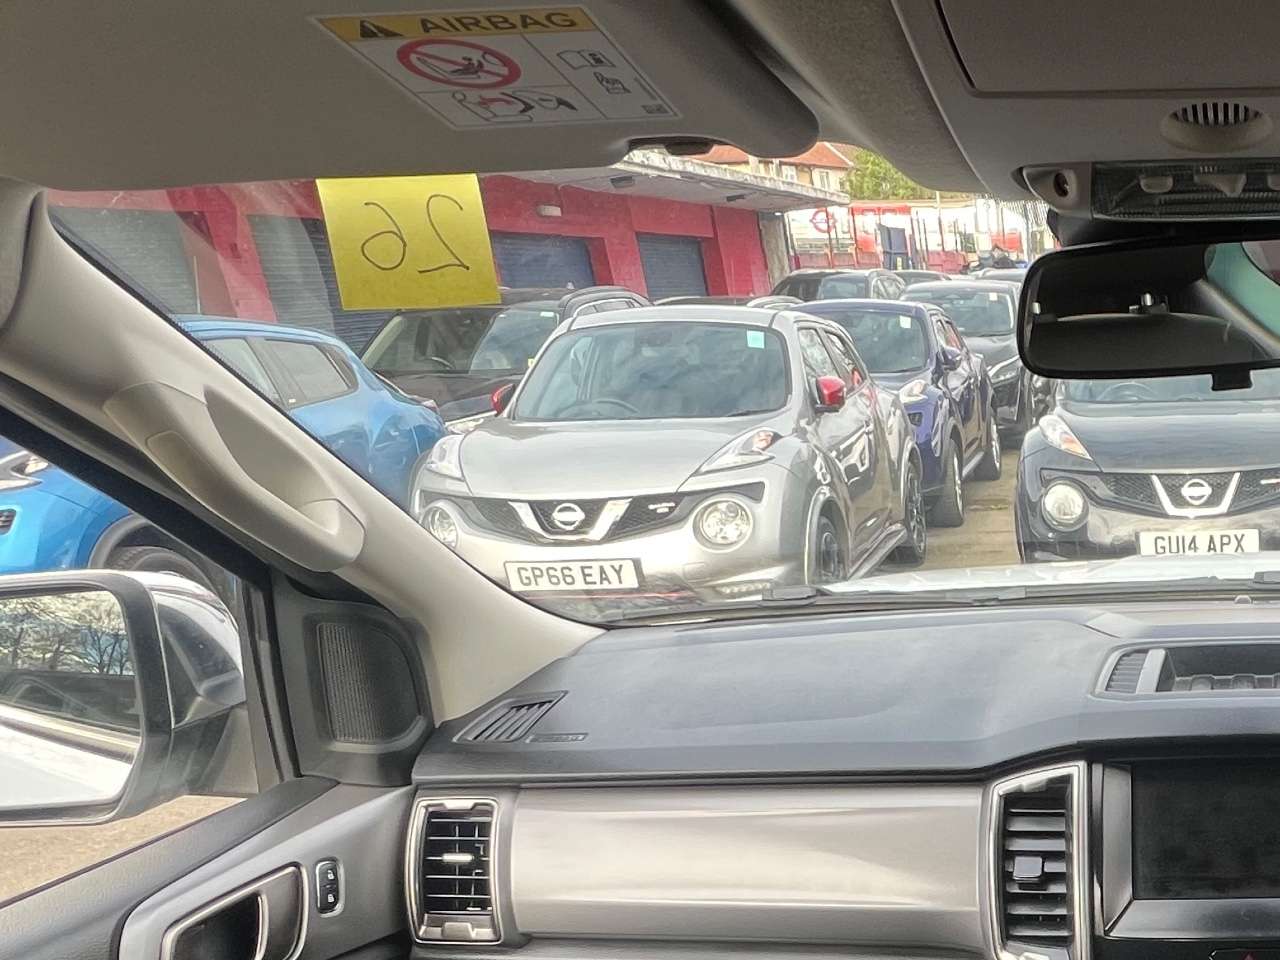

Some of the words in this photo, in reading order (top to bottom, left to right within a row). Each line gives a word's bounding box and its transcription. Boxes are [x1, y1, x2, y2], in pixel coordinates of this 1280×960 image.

[420, 12, 577, 33] AIRBAG
[1154, 535, 1199, 555] GU14
[1207, 533, 1245, 553] APX
[517, 566, 576, 587] GP66
[580, 564, 624, 585] EAY
